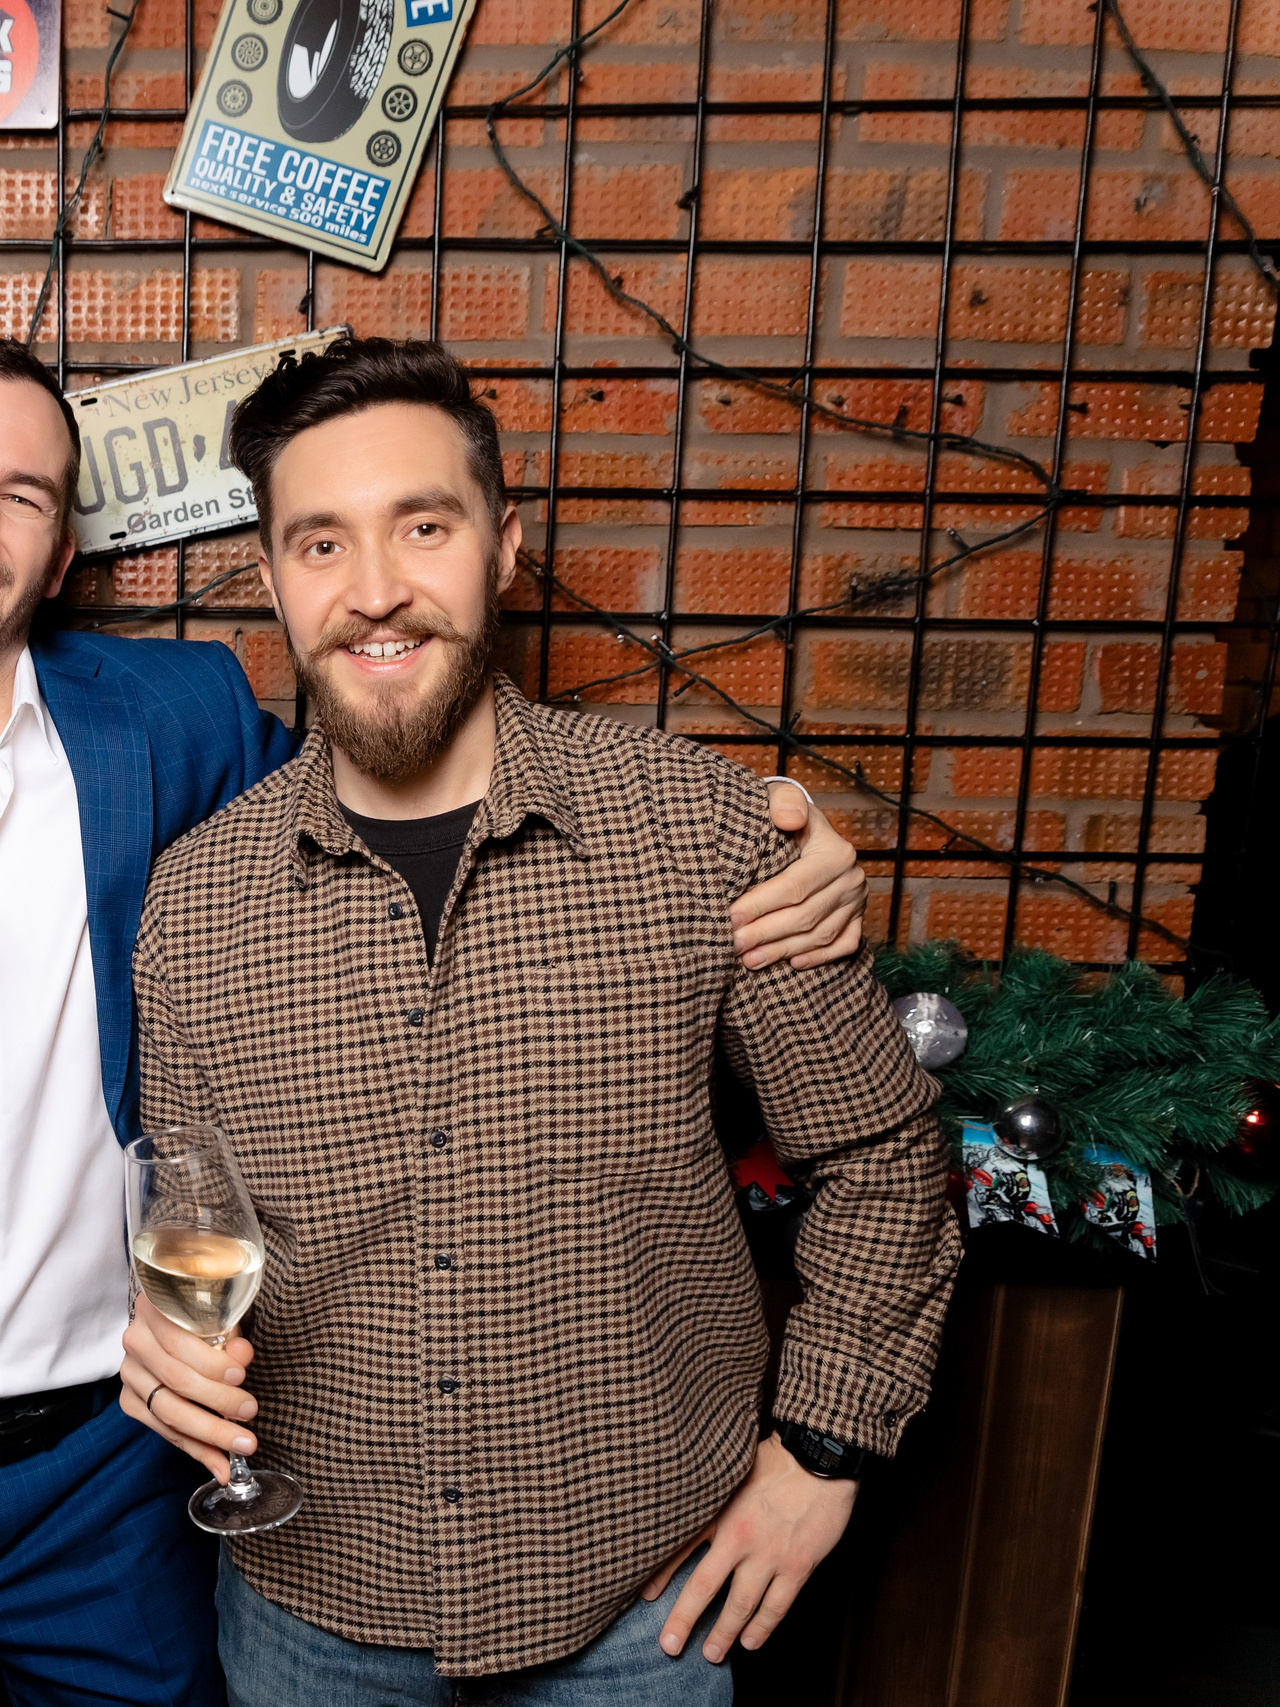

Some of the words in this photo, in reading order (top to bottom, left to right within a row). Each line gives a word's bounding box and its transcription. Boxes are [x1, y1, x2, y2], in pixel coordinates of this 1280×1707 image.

[194, 156, 277, 199] QUALITY
[279, 186, 296, 206] &
[300, 192, 376, 232] SAFETY
[200, 124, 275, 176] FREE
[277, 150, 385, 212] COFFEE
[190, 176, 228, 197] next
[229, 188, 288, 216] service
[288, 208, 323, 228] 500
[324, 222, 368, 243] miles
[105, 385, 172, 418] New
[179, 362, 268, 405] Jersey
[127, 498, 220, 533] Garden
[228, 487, 257, 509] St
